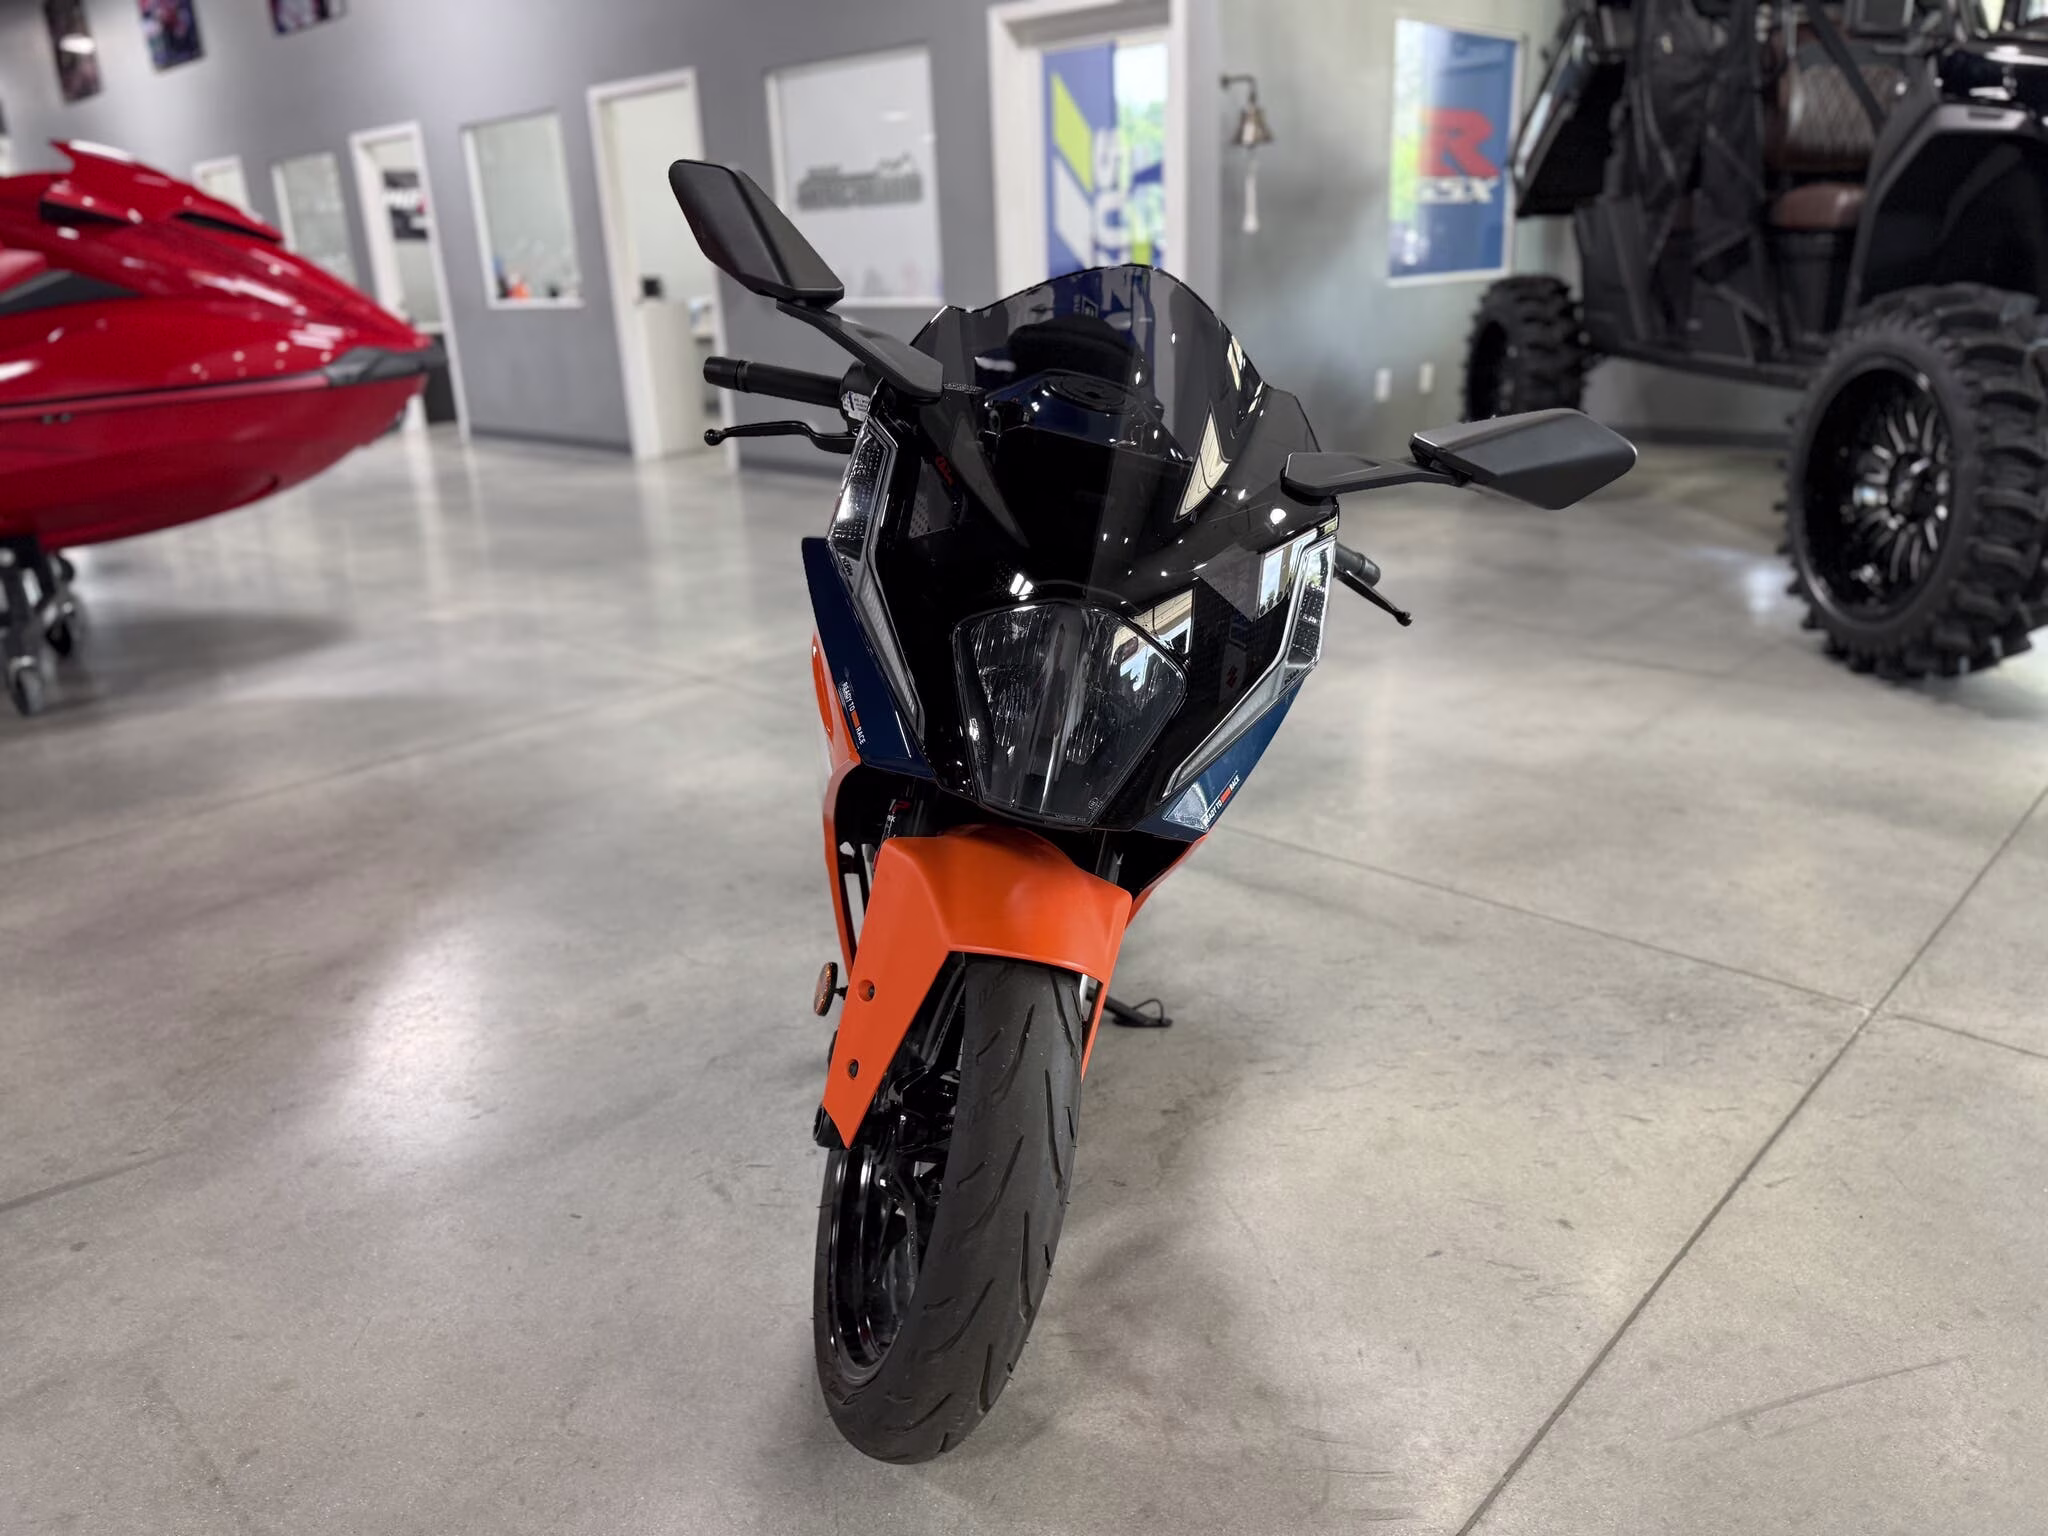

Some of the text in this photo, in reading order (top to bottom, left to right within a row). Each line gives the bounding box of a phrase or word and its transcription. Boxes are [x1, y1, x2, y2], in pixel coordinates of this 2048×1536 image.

[1417, 107, 1499, 175] R
[842, 681, 866, 745] READY TO RACE
[1201, 774, 1240, 827] EADY TO RACE
